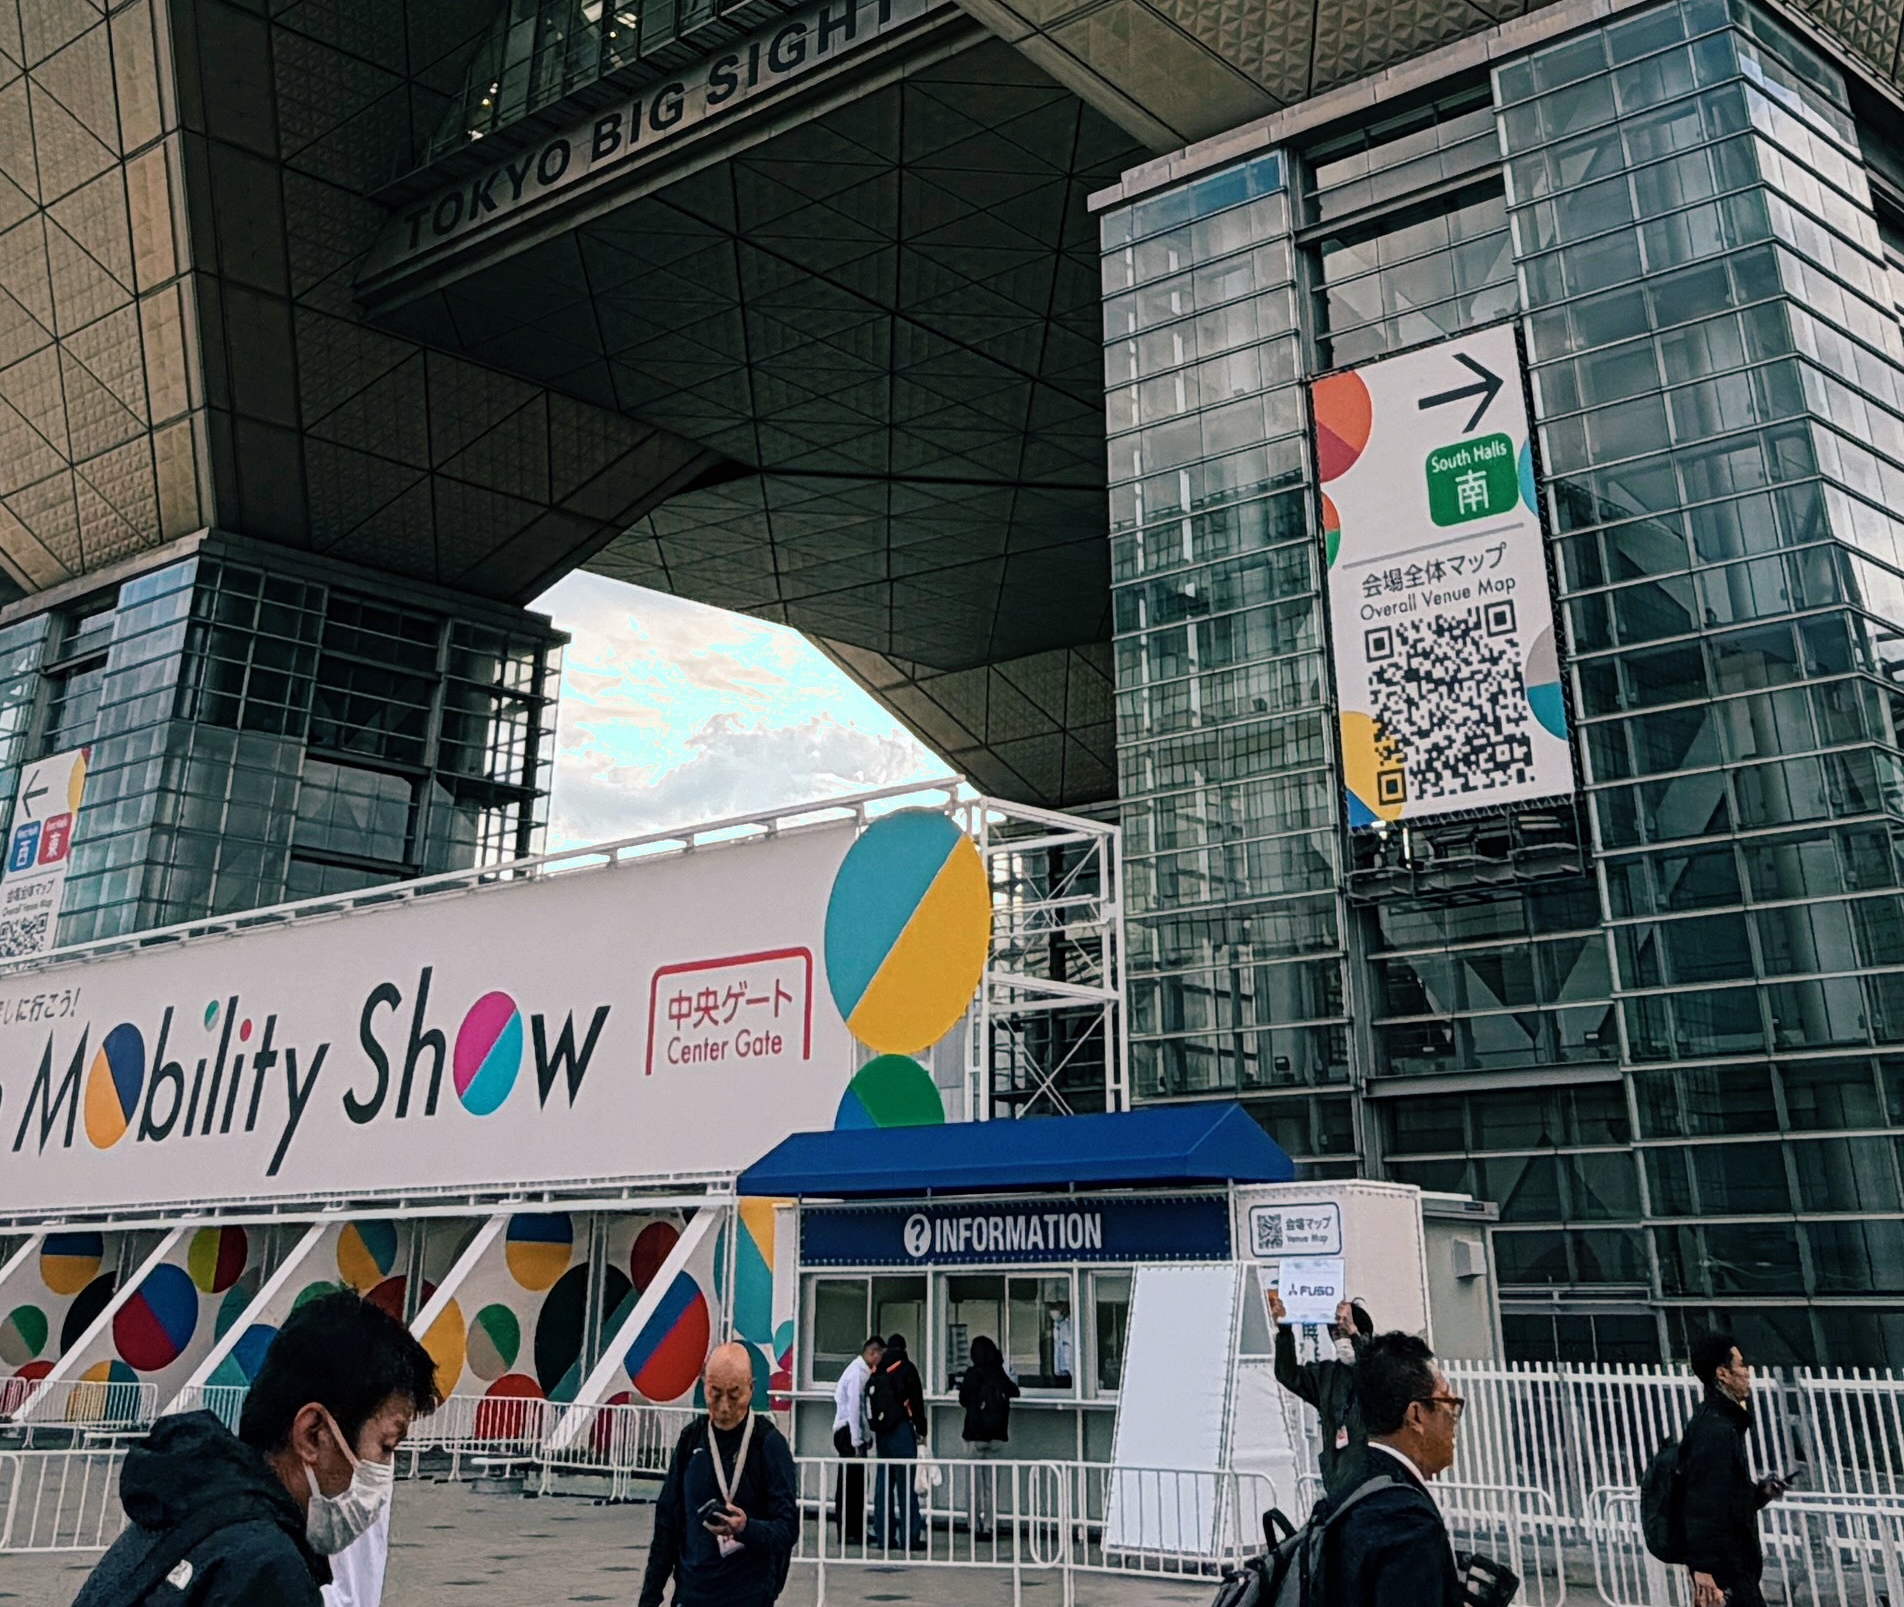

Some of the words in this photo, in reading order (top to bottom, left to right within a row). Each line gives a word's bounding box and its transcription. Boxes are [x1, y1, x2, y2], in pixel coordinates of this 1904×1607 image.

[404, 138, 571, 251] TOKYO
[590, 81, 686, 163] BIG
[1431, 448, 1471, 474] South
[1473, 439, 1507, 463] Halls
[1455, 469, 1489, 515] 南
[1362, 541, 1507, 599] 会場全体マップ
[1360, 592, 1416, 621] Overall
[1421, 588, 1471, 607] Venue
[1478, 577, 1516, 596] Map
[667, 978, 793, 1032] 中央ゲート
[667, 1036, 729, 1065] Center
[735, 1028, 782, 1058] Gate
[11, 994, 331, 1177] Mobility
[343, 966, 612, 1124] Show
[934, 1212, 1102, 1254] INFORMATION
[1299, 1285, 1335, 1297] FUSO
